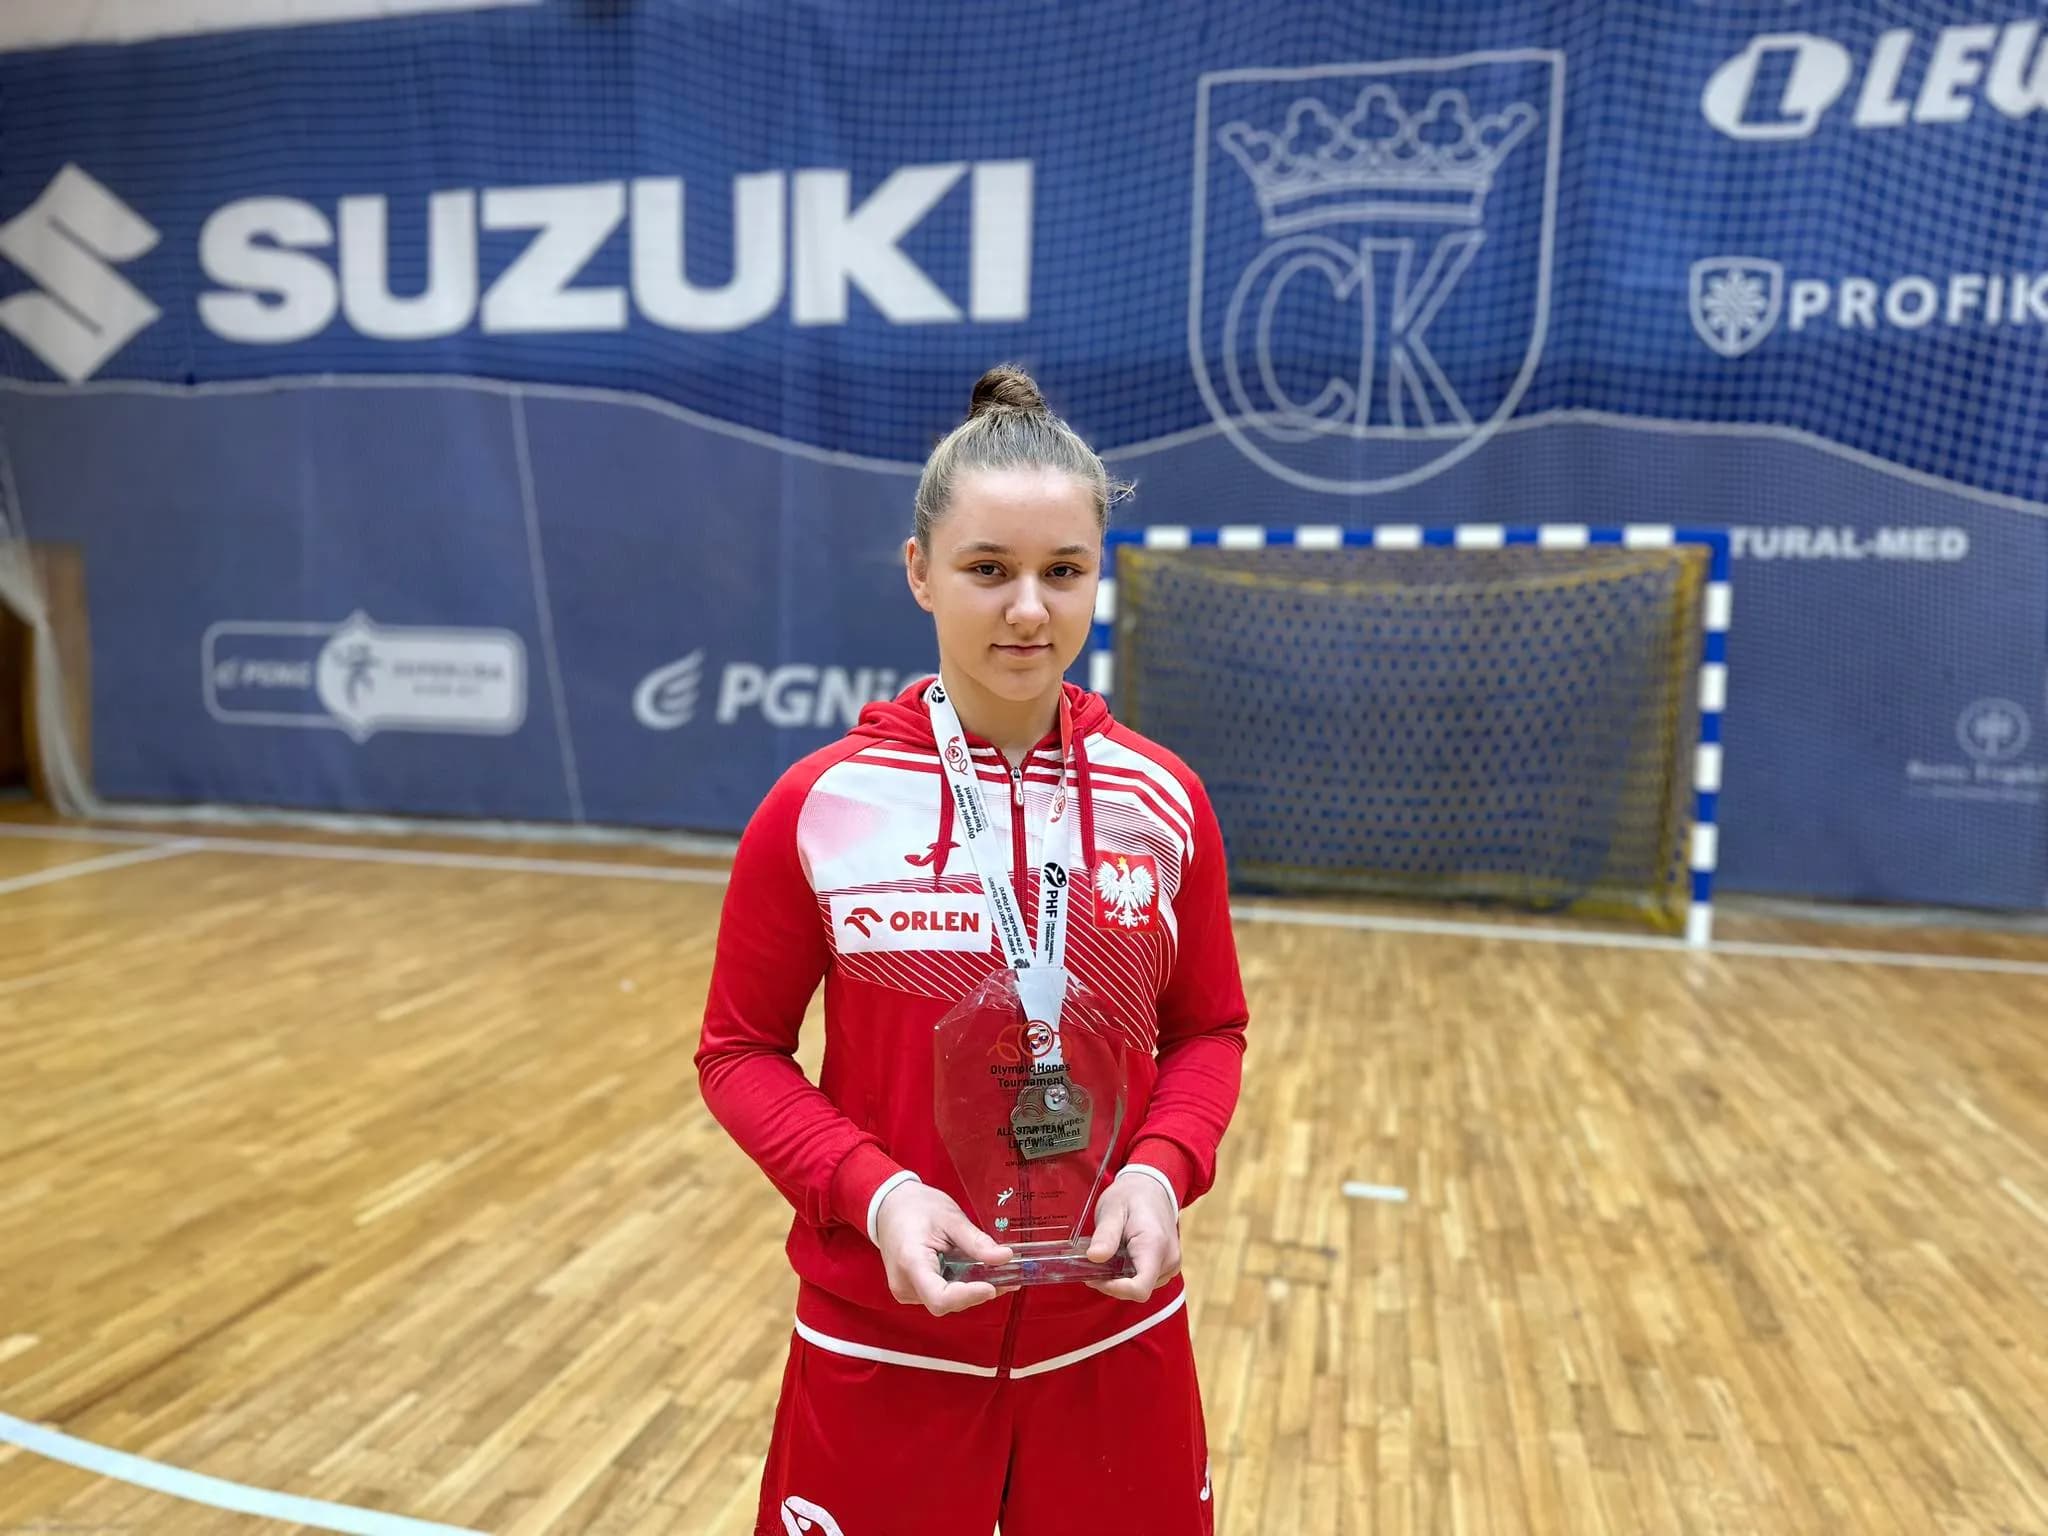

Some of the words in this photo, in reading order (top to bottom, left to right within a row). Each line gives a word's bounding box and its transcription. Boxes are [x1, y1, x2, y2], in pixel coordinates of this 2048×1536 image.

[198, 160, 1032, 343] SUZUKI
[1222, 230, 1486, 444] CK
[954, 784, 965, 809] Hopes
[964, 787, 982, 833] Tournament
[962, 809, 975, 840] Olympic
[1046, 890, 1058, 918] PHF
[889, 911, 979, 932] ORLEN
[990, 1064, 1035, 1075] Olympic
[1037, 1062, 1071, 1075] Hopes
[998, 1076, 1064, 1088] Tournament
